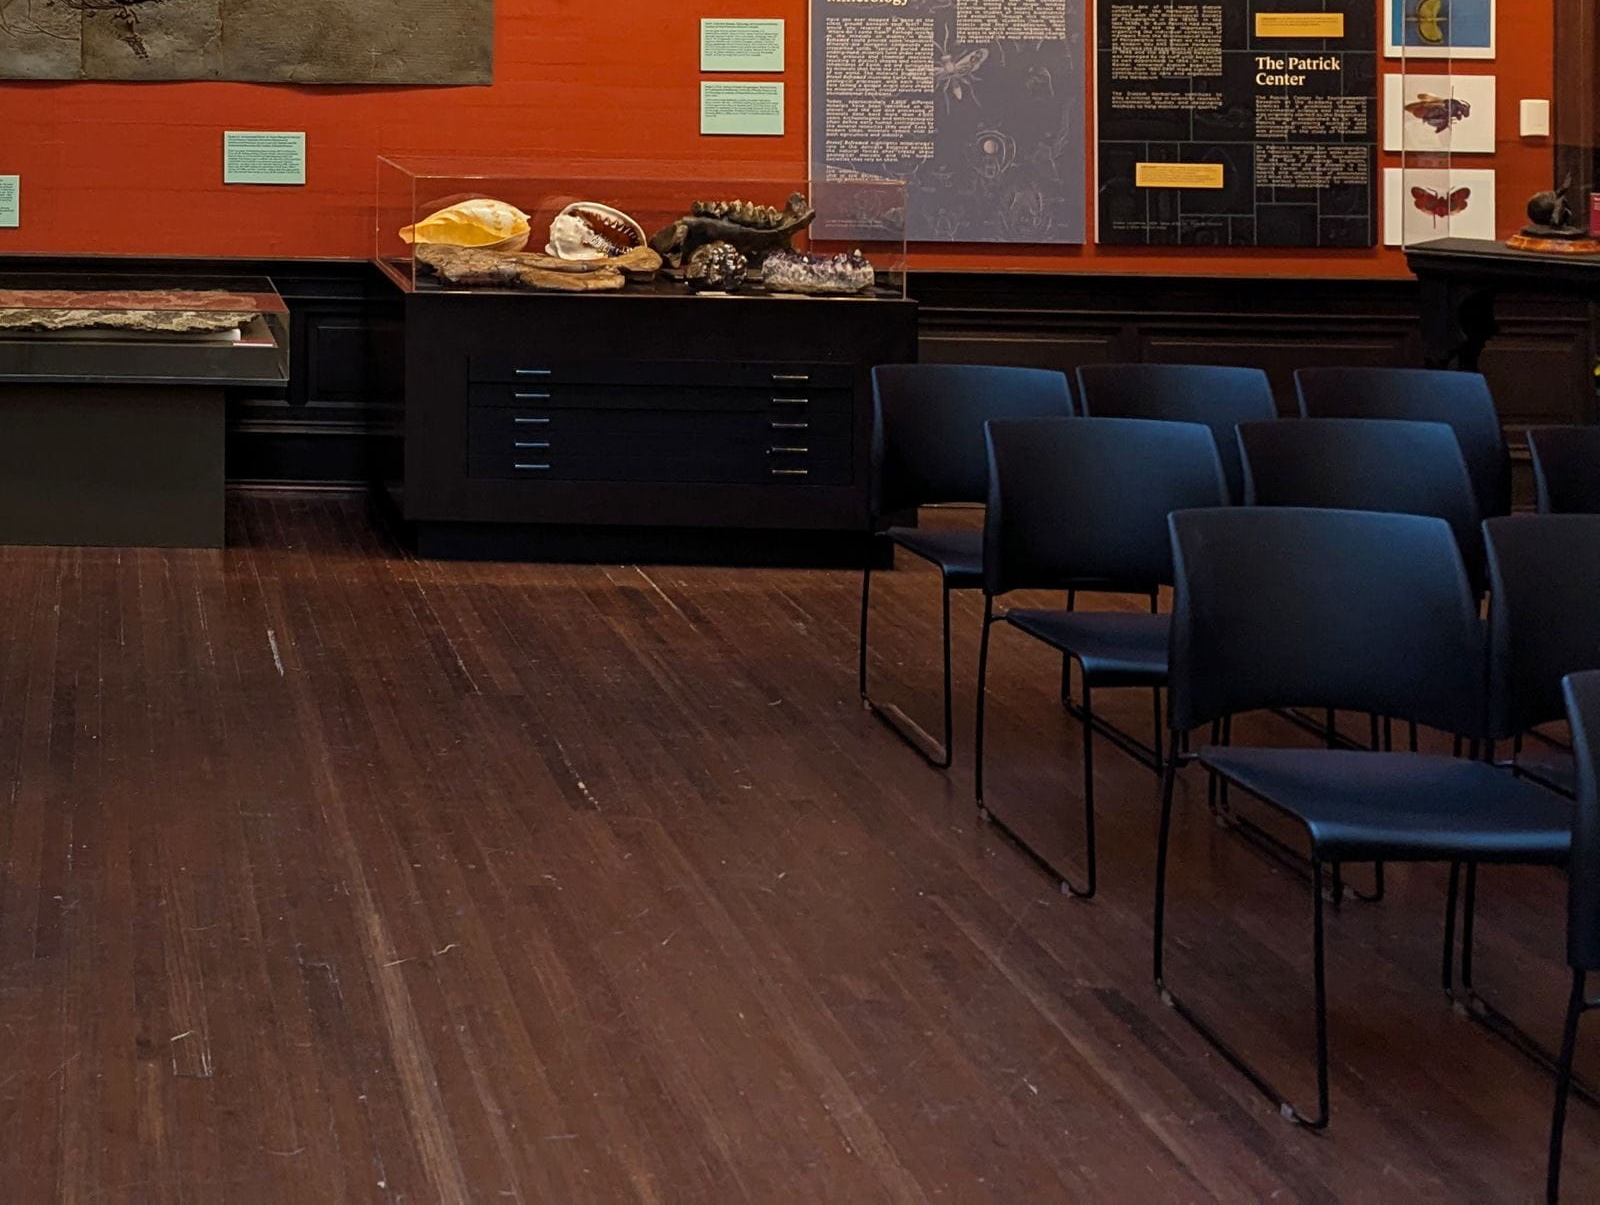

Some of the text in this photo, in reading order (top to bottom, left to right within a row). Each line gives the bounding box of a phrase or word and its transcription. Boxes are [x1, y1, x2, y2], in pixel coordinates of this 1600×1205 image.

[1256, 56, 1340, 70] The Patrick
[1256, 72, 1306, 86] Center
